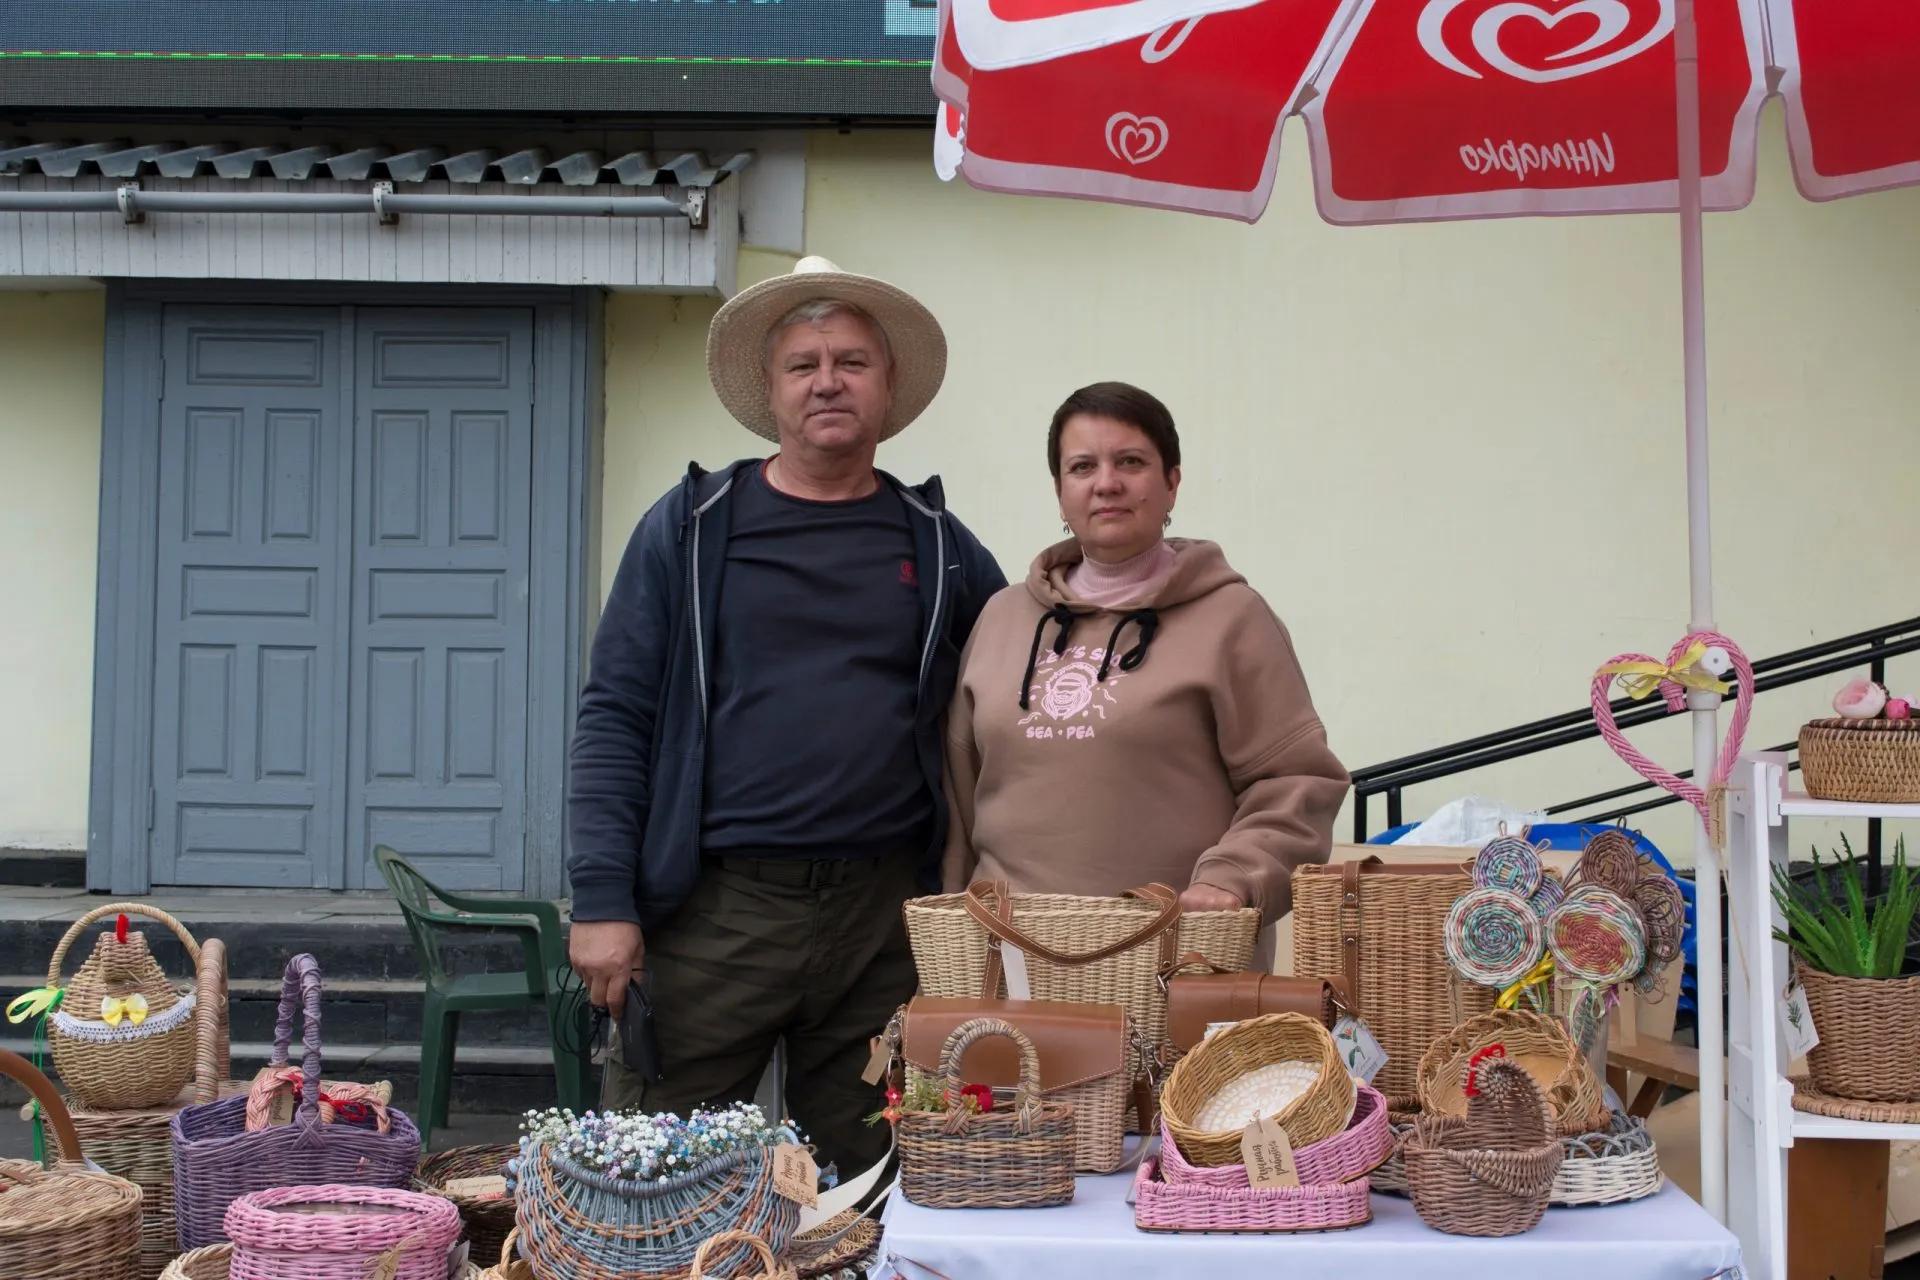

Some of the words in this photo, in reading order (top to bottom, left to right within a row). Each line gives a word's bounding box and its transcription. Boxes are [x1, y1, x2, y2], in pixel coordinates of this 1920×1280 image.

[1026, 725, 1054, 739] SEA
[1066, 725, 1095, 740] PEA
[1252, 1144, 1273, 1182] Ручная
